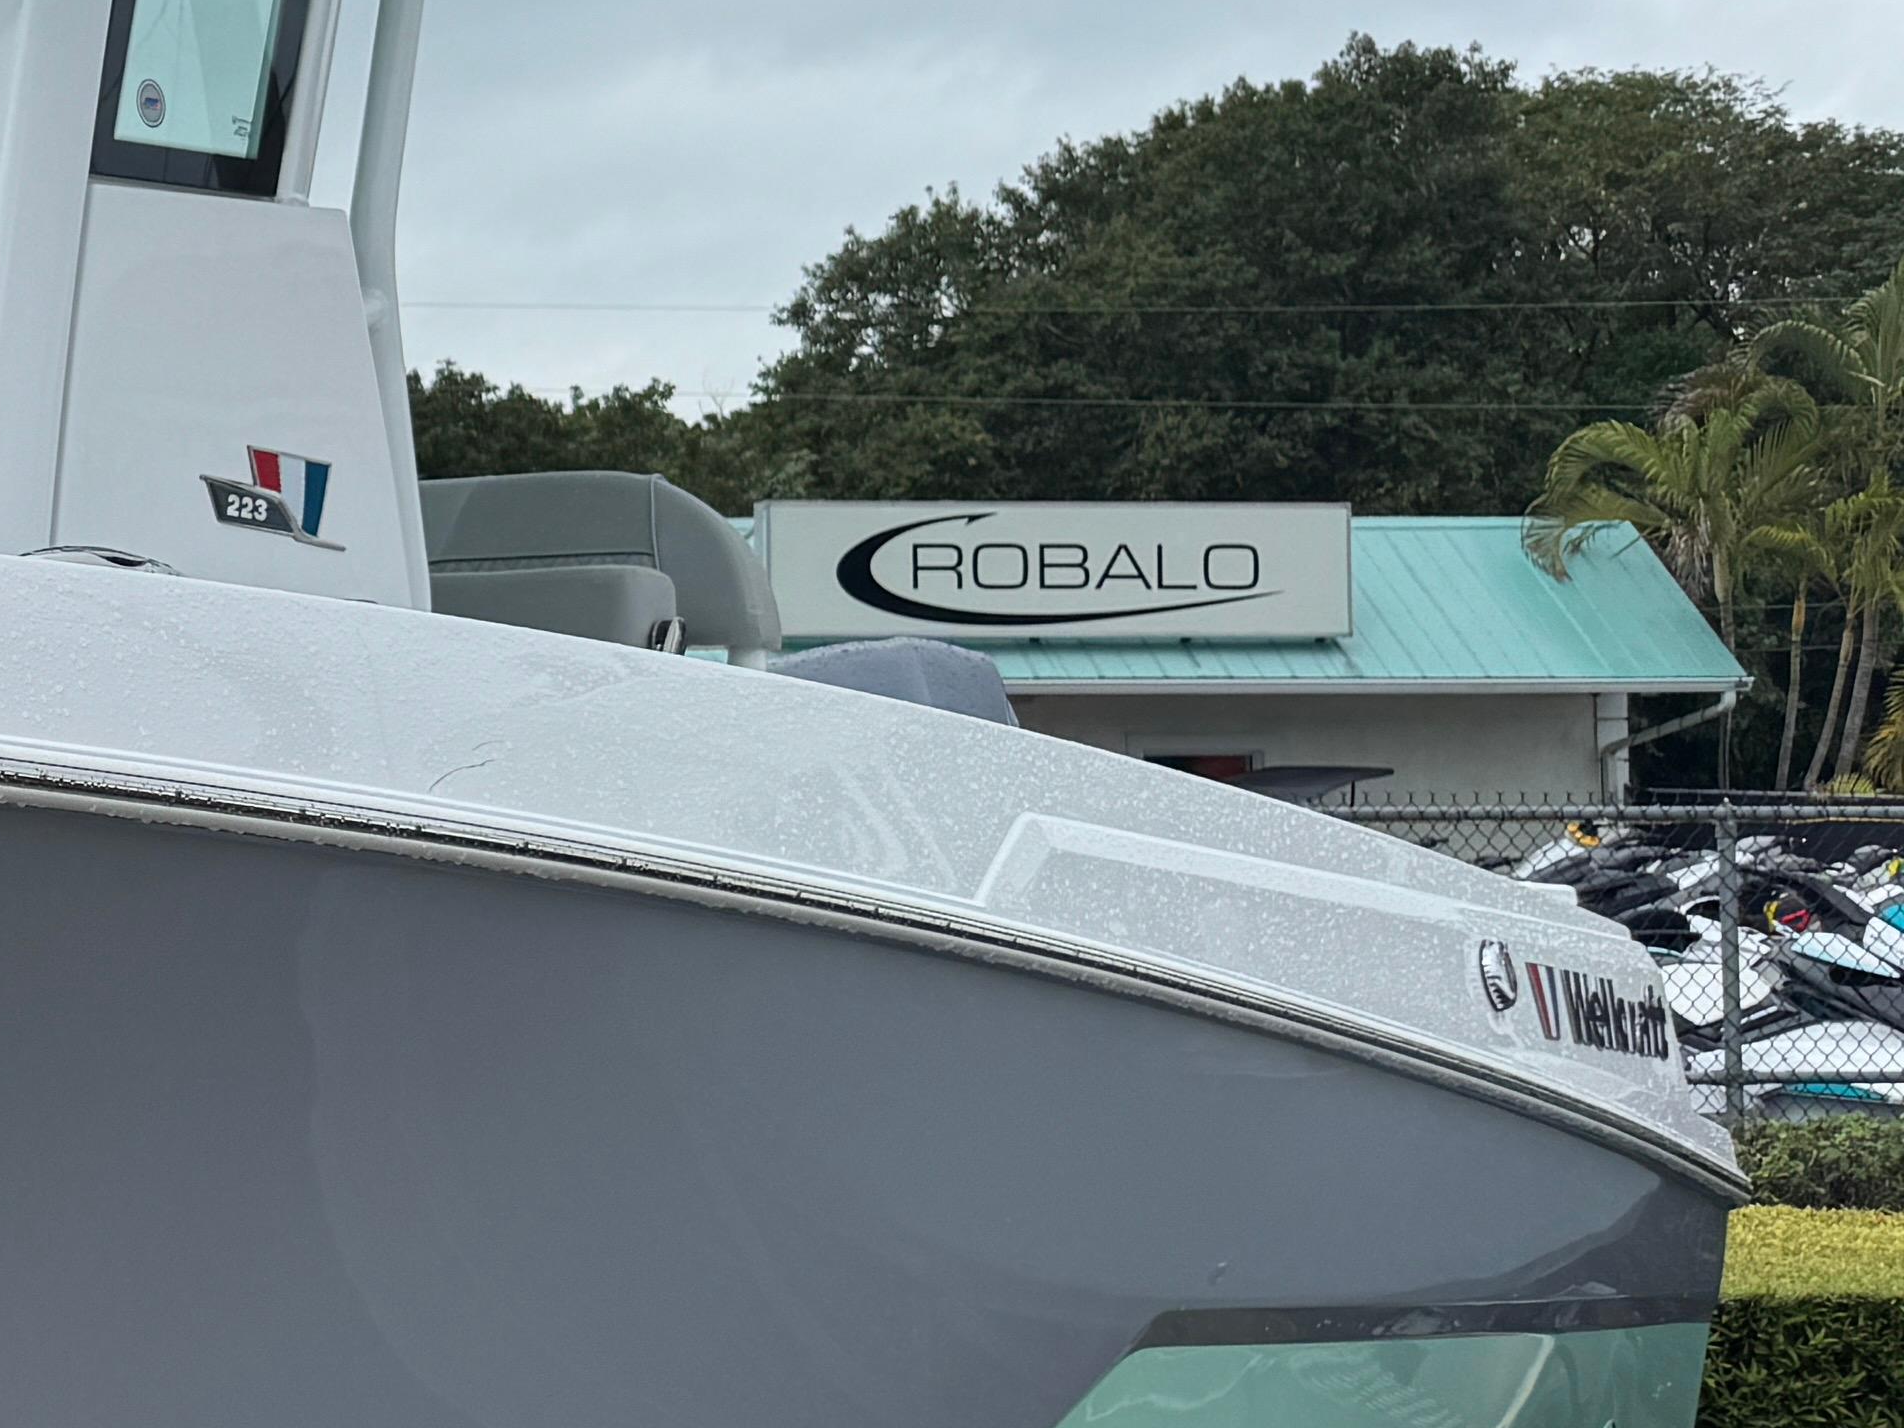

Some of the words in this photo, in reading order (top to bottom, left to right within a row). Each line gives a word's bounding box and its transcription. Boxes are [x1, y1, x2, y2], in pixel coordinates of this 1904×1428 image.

[226, 494, 268, 522] 223
[911, 543, 1260, 590] ROBALO
[1560, 968, 1669, 1062] Wellcraft
